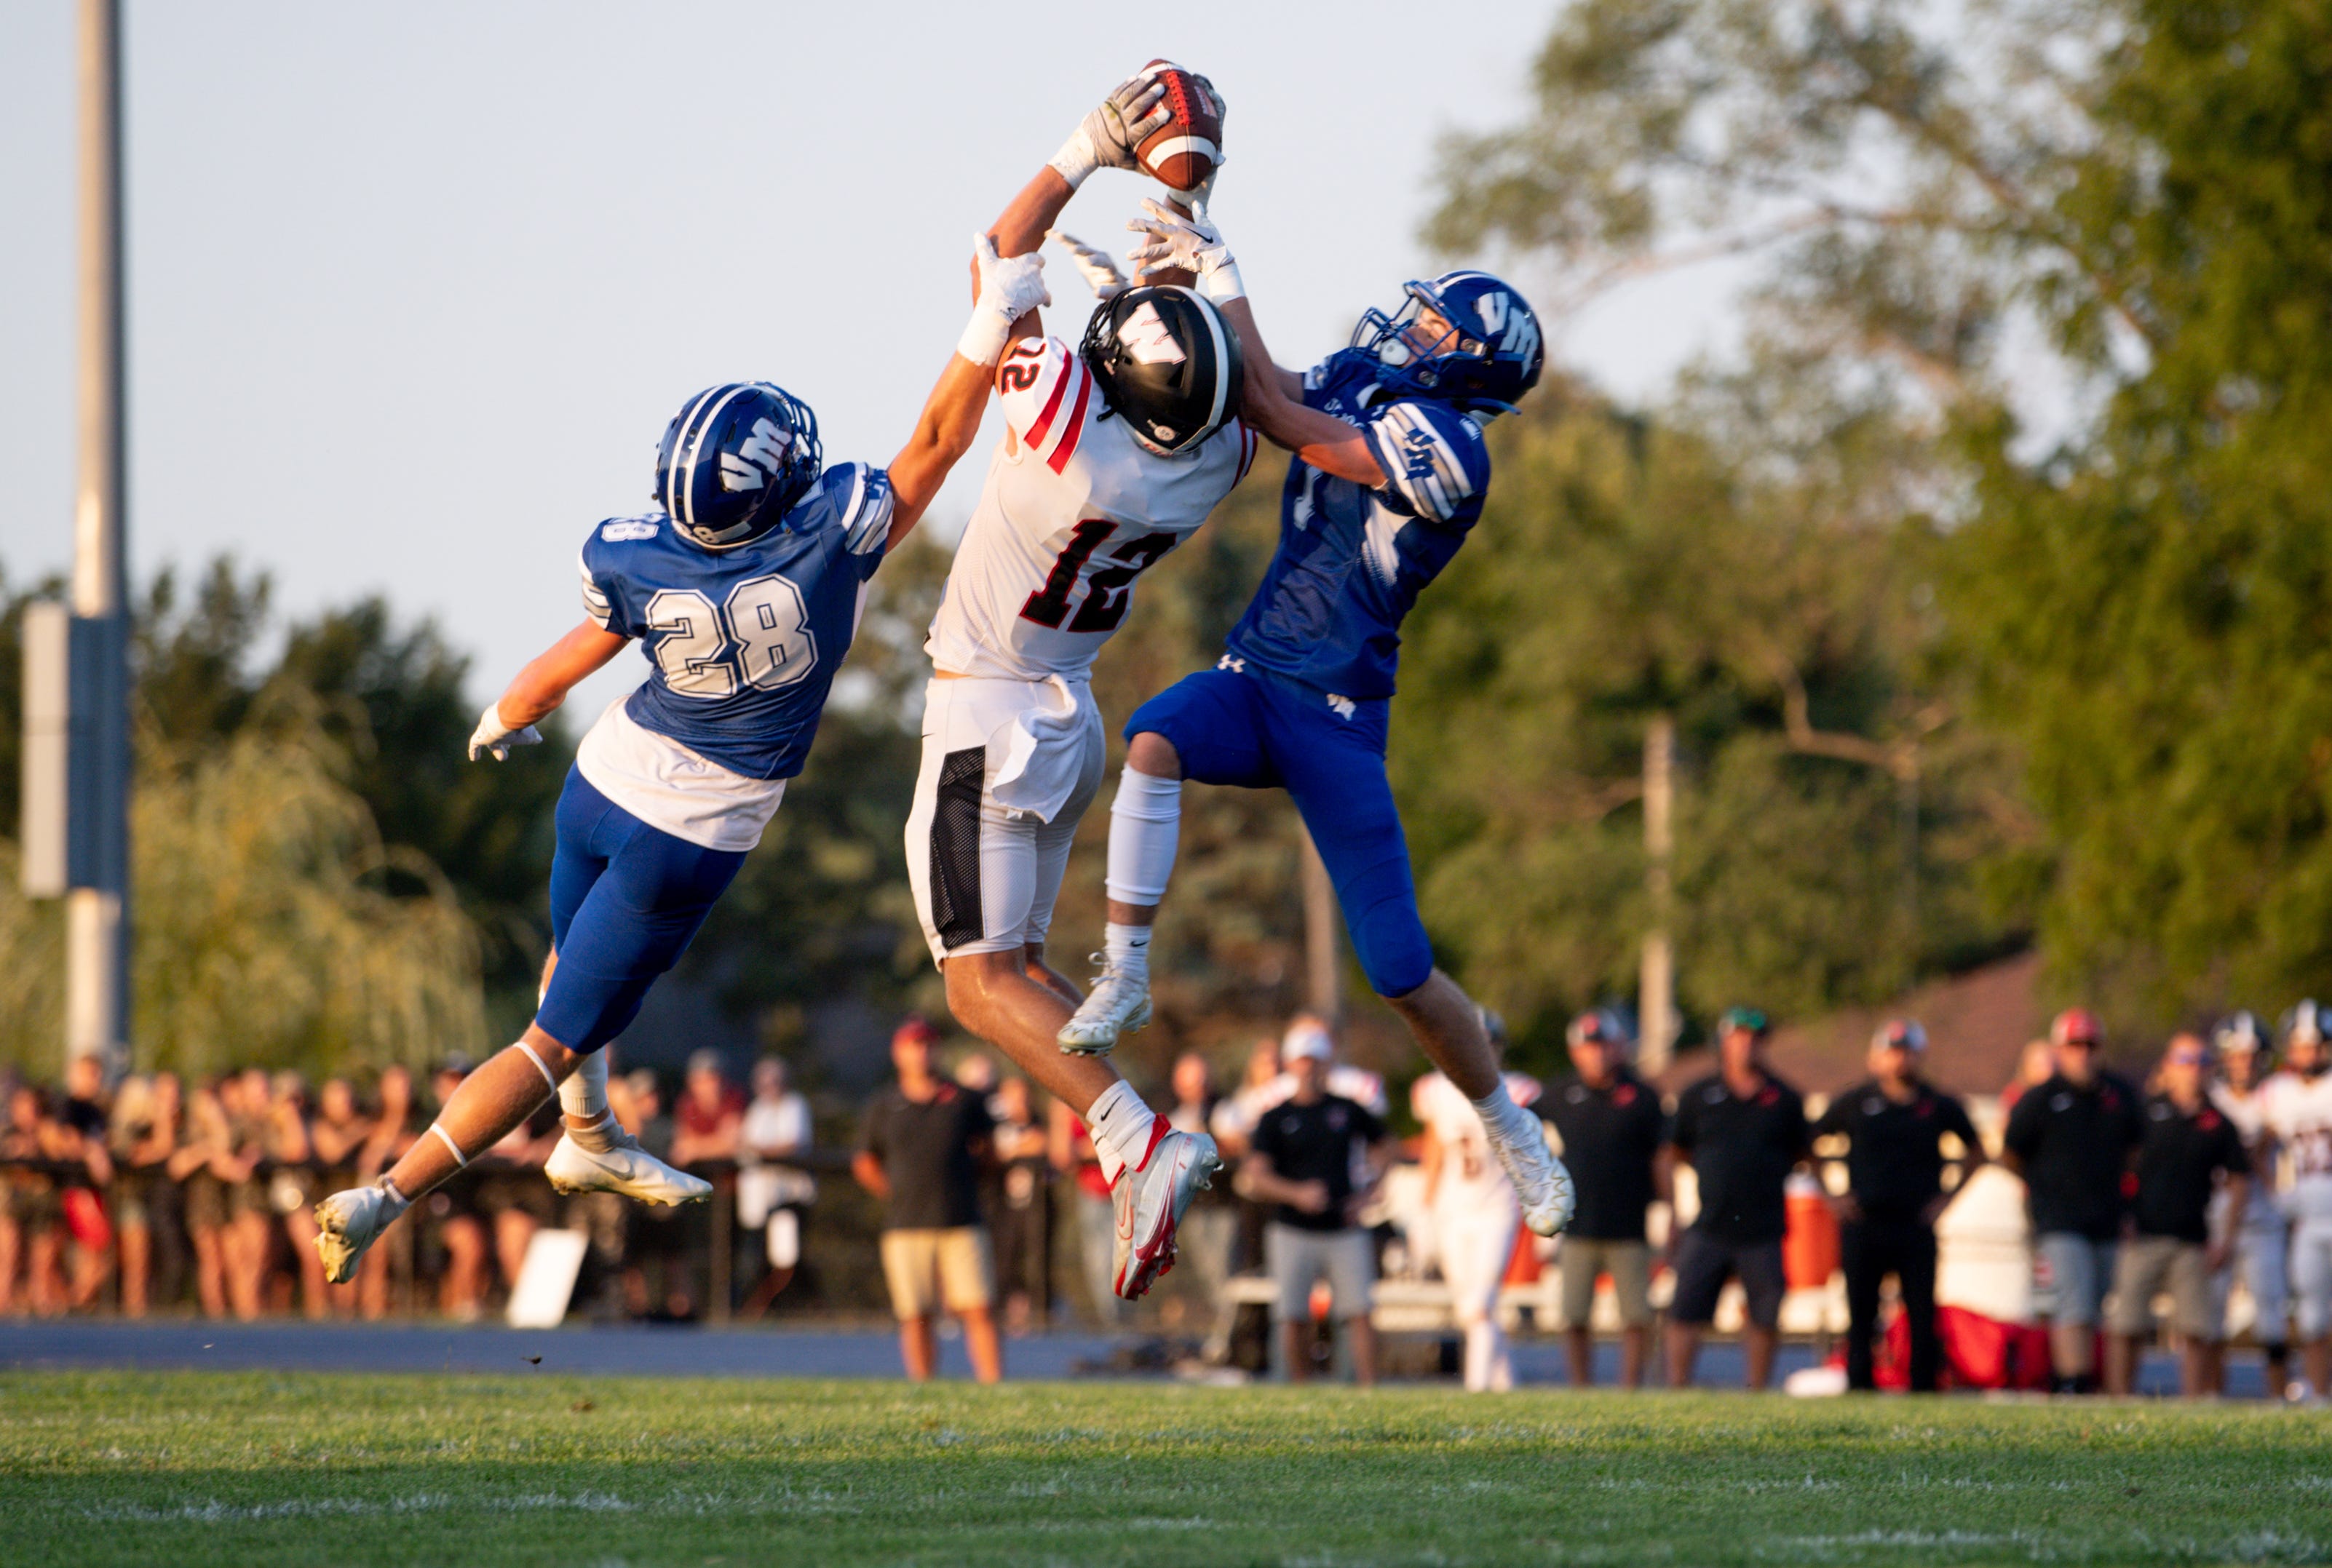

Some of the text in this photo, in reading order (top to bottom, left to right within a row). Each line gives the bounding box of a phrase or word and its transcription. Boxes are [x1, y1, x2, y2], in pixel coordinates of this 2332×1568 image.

[1117, 300, 1187, 365] W
[719, 416, 793, 493] VM
[1019, 518, 1178, 633] 12
[645, 573, 819, 699] 28
